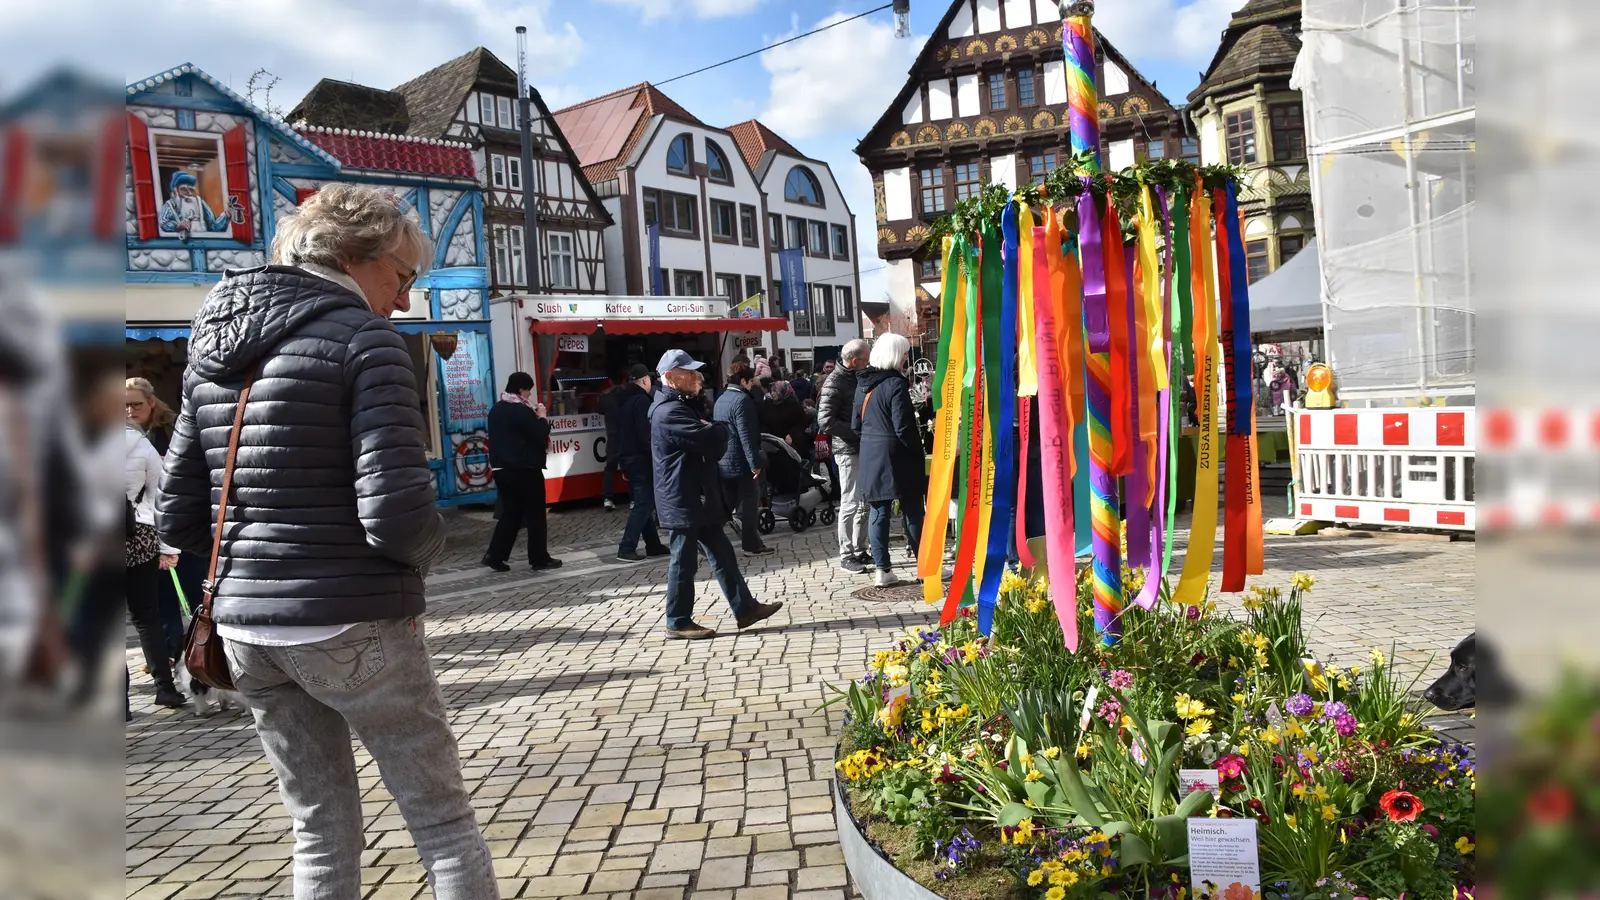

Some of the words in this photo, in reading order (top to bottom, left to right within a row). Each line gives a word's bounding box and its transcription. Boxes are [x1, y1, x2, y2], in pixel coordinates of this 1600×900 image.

[537, 303, 562, 313] Slush
[605, 303, 632, 313] Kaffee
[667, 303, 704, 314] Capri-Sun
[559, 336, 585, 350] Crêpes
[735, 336, 759, 348] Crêpes
[1200, 355, 1212, 469] ZUSAMMENHALT
[548, 419, 577, 430] Kaffee
[551, 438, 580, 453] illy's
